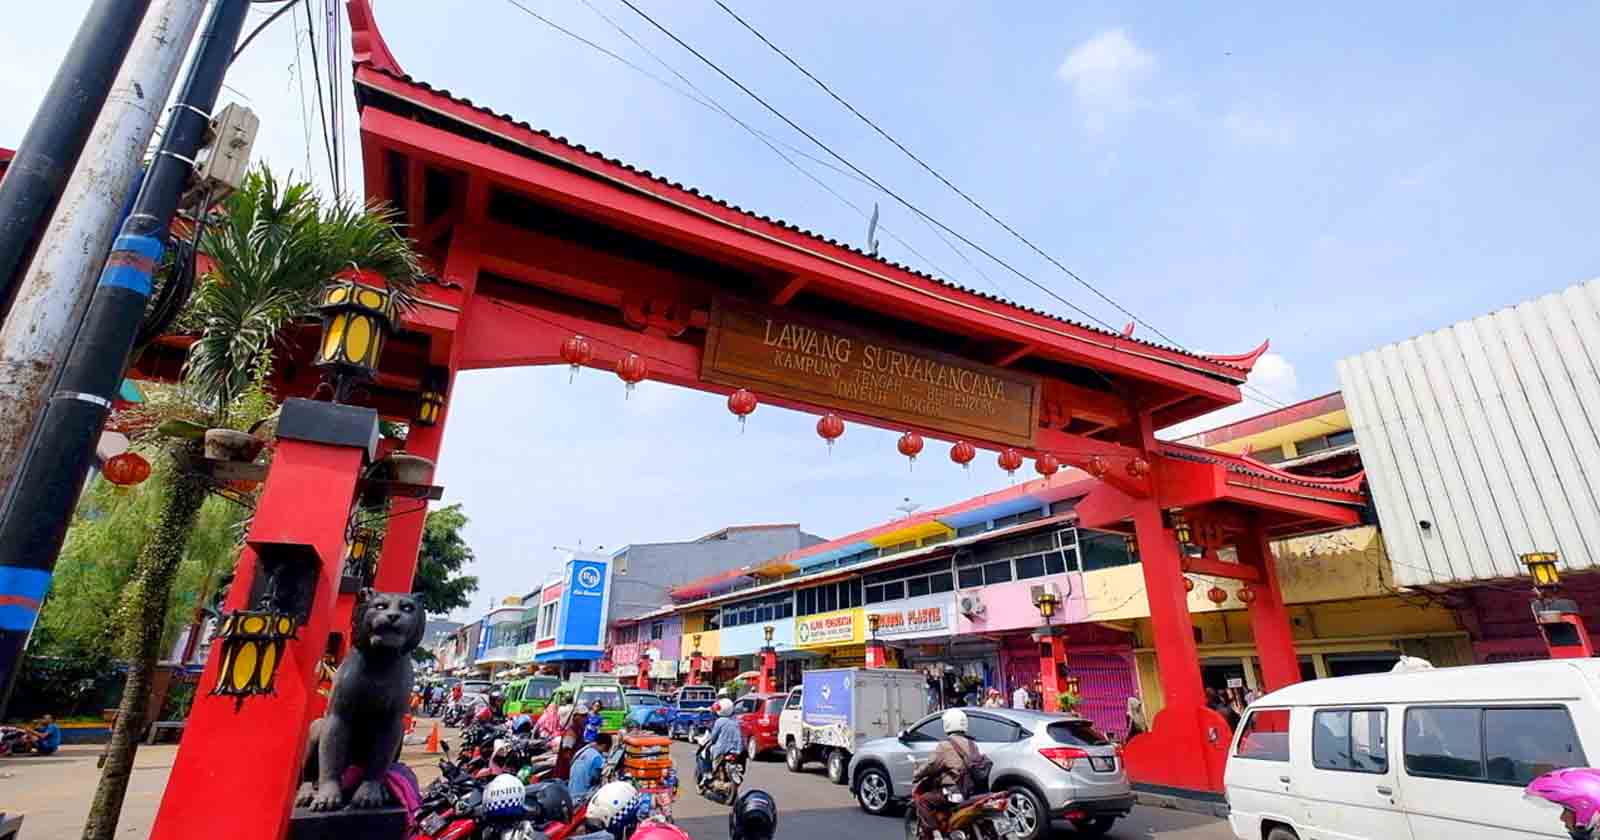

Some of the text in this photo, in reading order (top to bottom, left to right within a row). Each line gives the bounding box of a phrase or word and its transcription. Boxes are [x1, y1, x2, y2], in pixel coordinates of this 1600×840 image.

[763, 319, 1006, 400] LAWANG SURYAKANCANA
[774, 350, 841, 379] KAMPUNG
[855, 368, 902, 393] TENGAH
